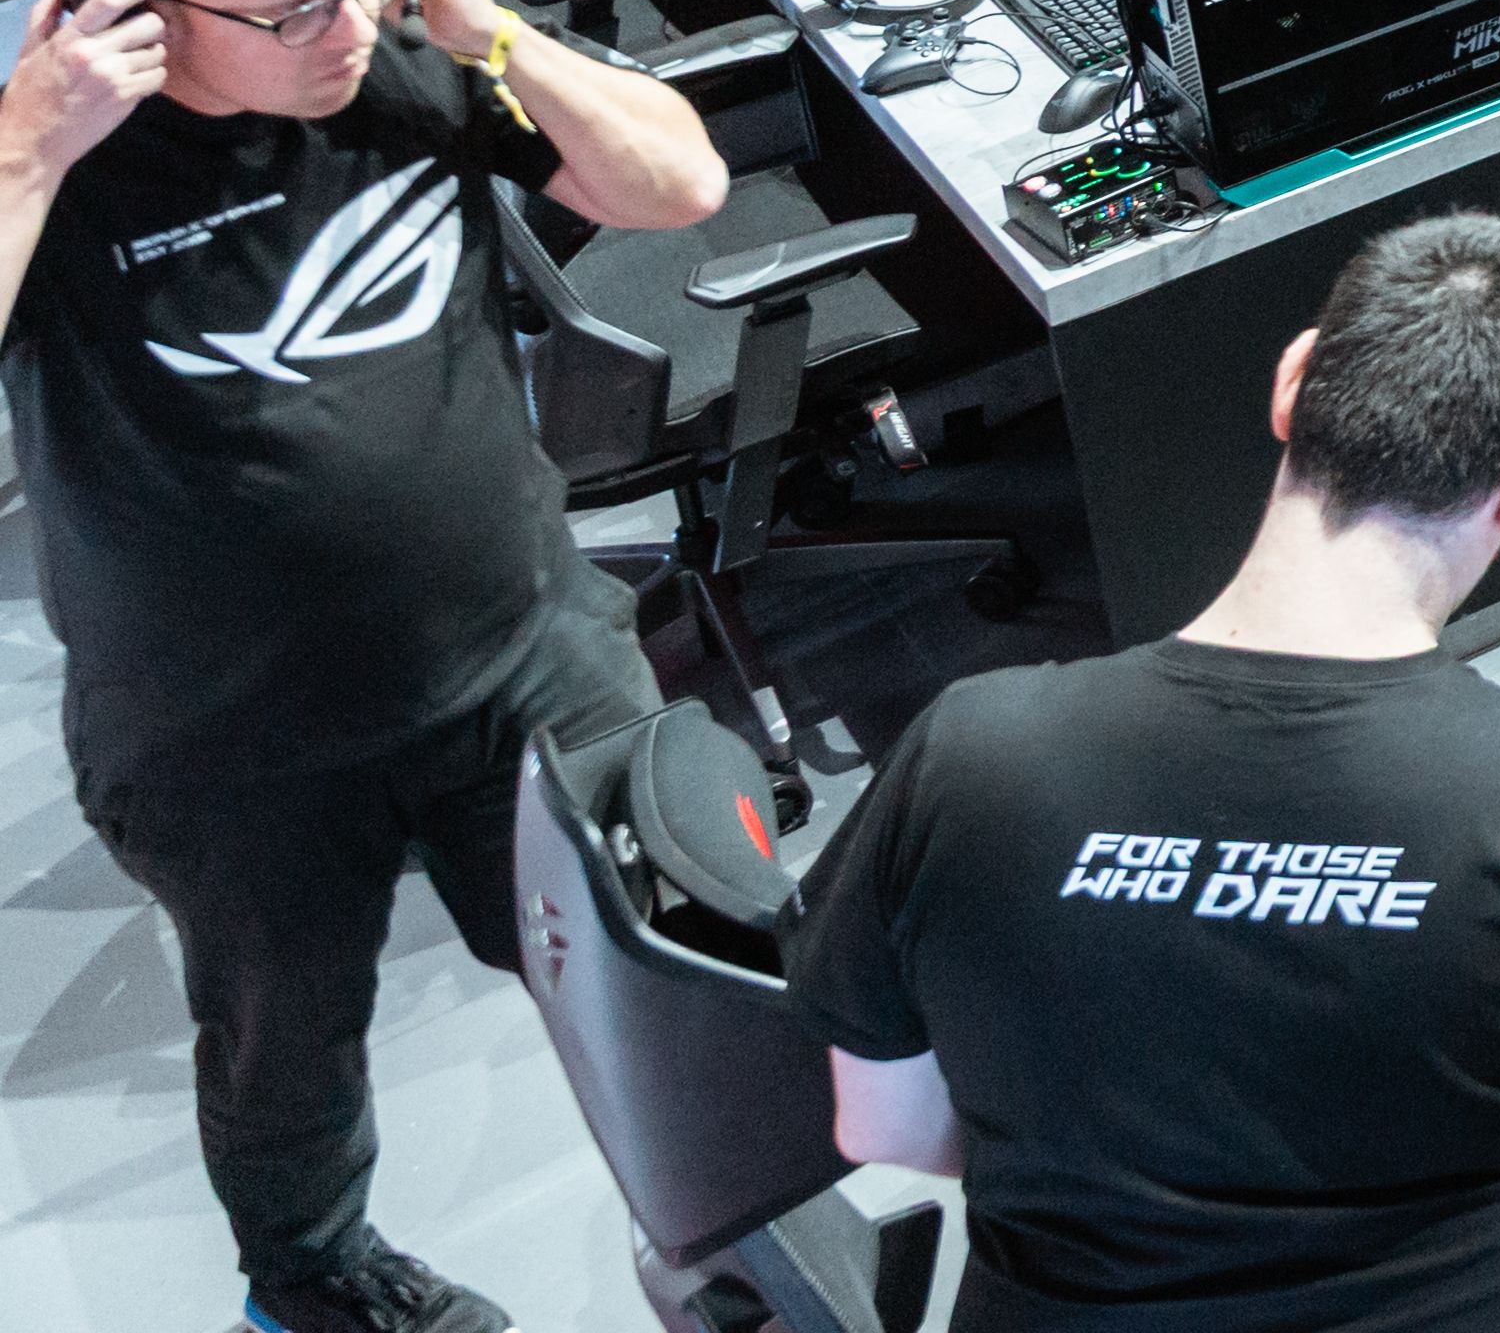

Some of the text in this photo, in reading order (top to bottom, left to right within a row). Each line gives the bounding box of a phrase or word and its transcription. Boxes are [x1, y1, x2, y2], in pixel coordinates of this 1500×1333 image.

[1386, 85, 1416, 101] ROG
[1426, 69, 1457, 87] MIKU
[889, 411, 916, 451] HEIGHT
[1077, 831, 1405, 880] FOR THOSE
[1059, 866, 1438, 931] WHO DARE
